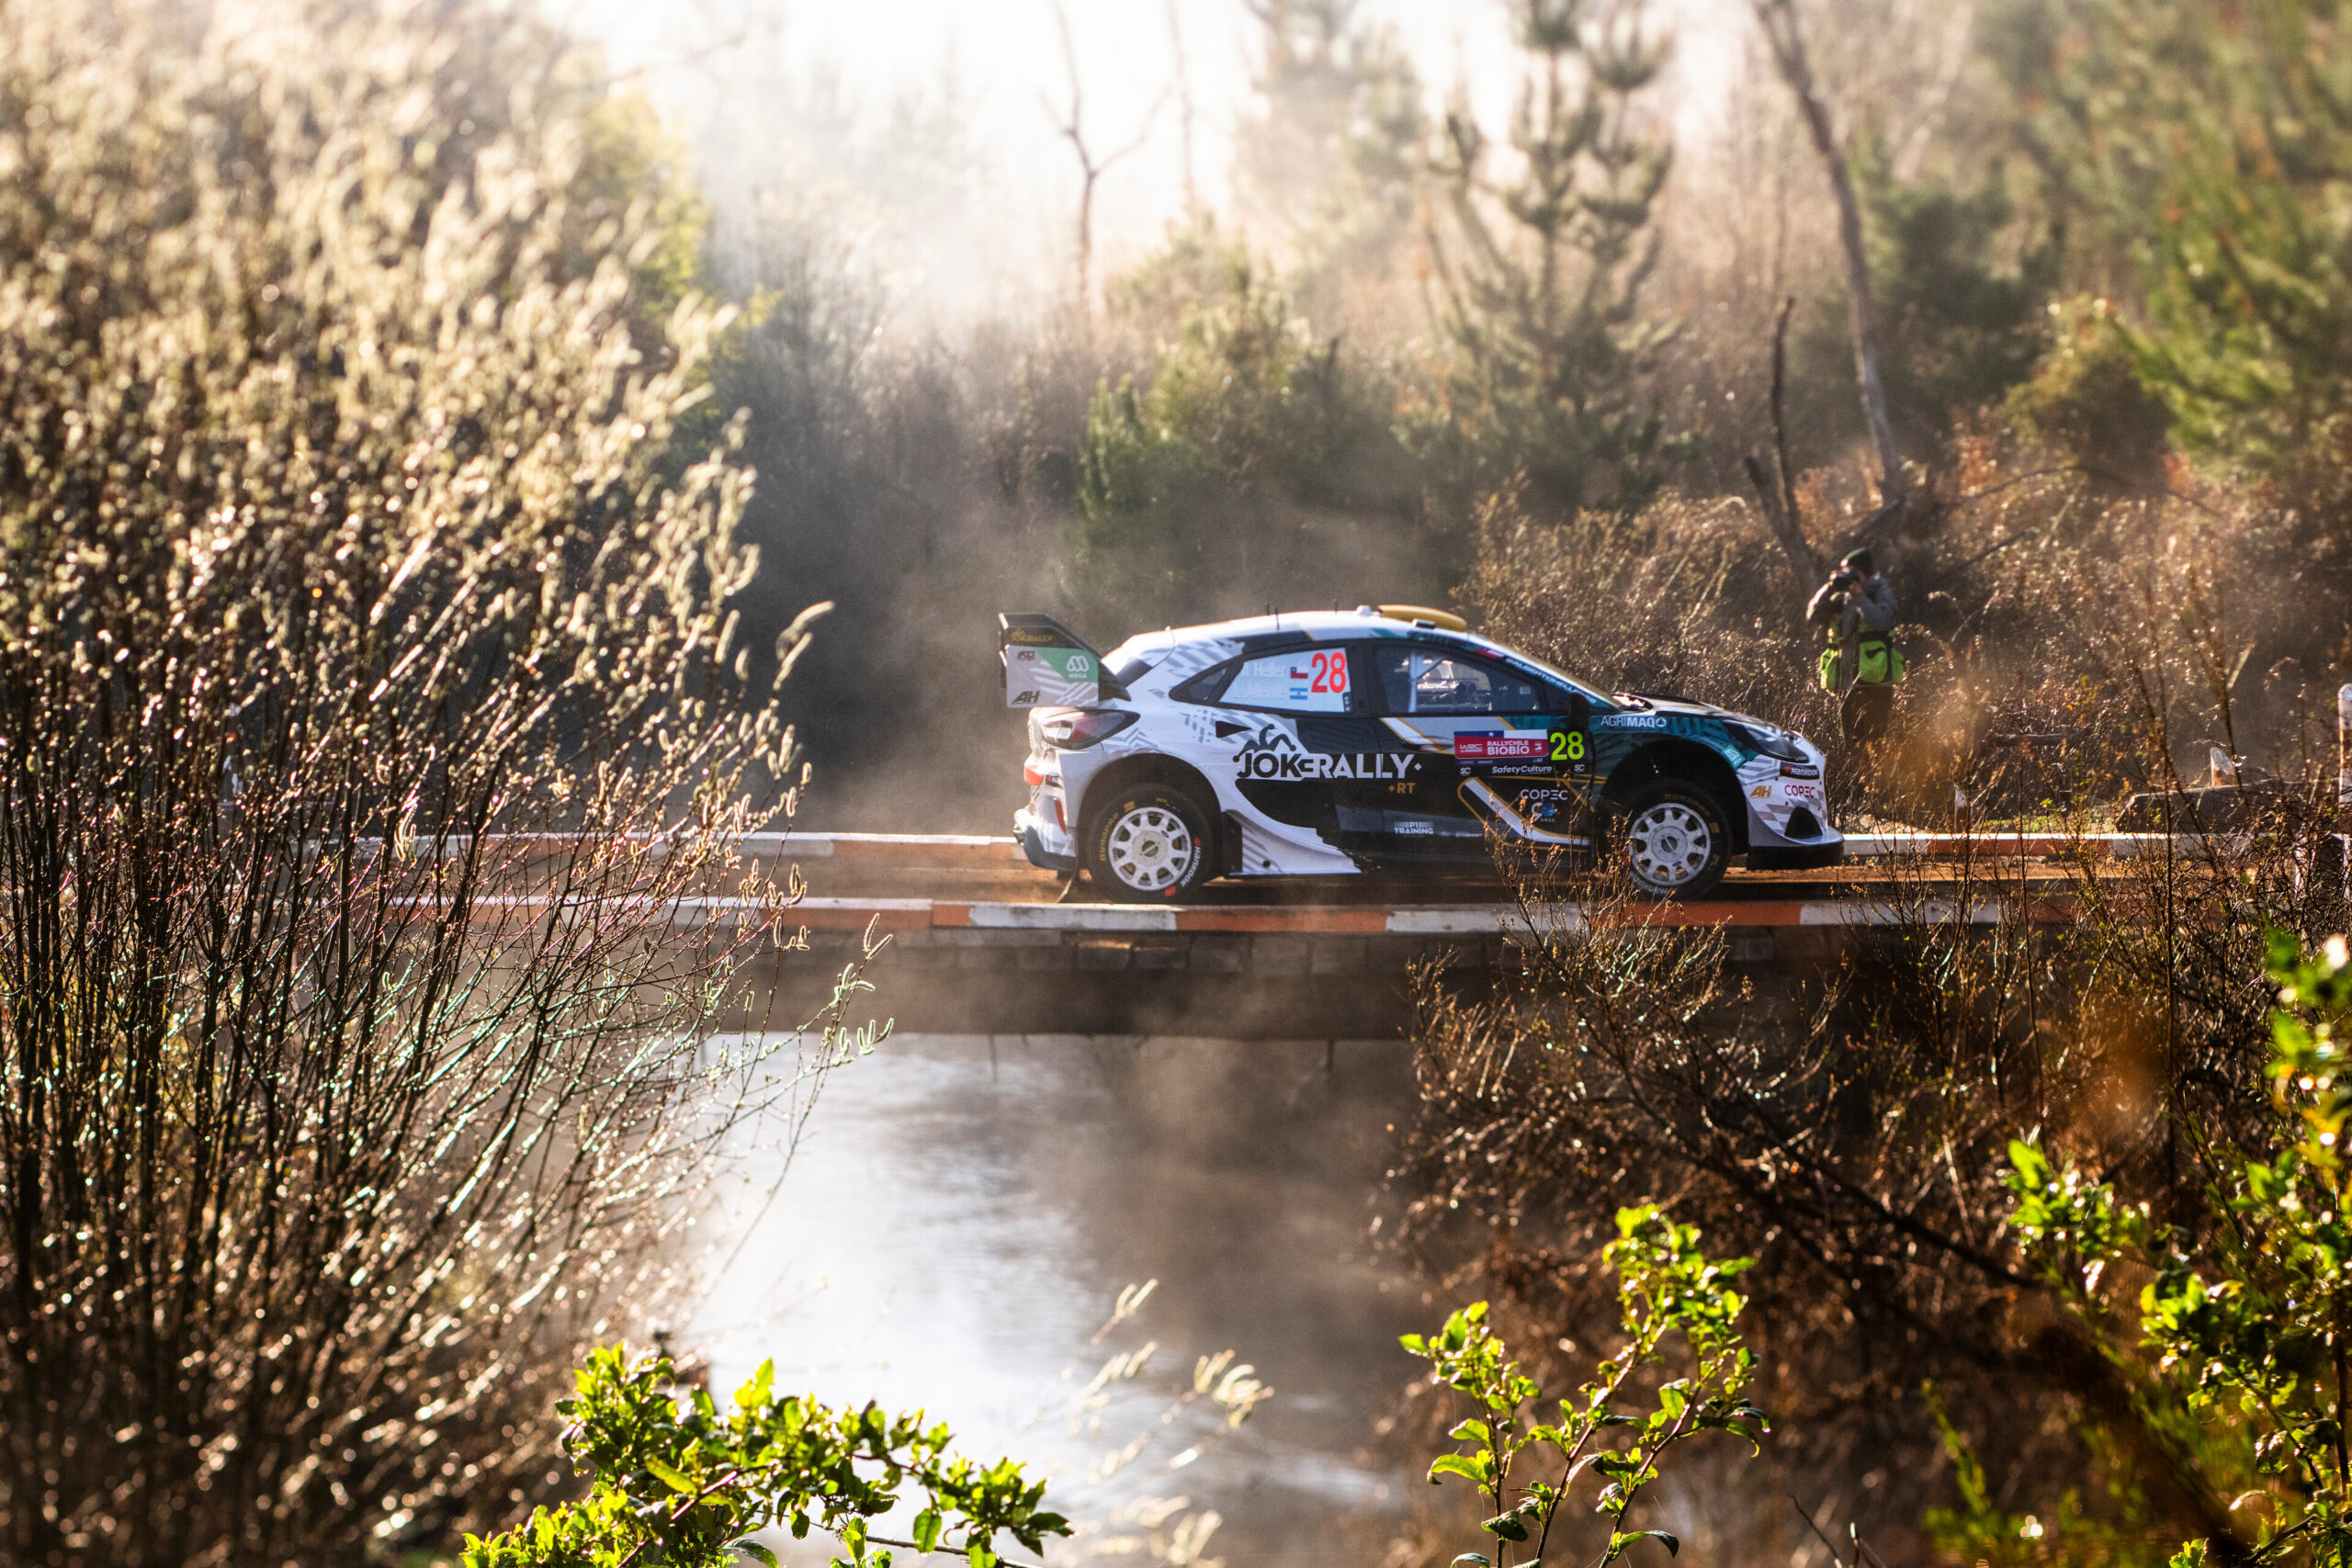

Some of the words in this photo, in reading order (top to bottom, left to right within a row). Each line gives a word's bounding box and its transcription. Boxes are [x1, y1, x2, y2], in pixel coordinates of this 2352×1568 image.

[1254, 661, 1286, 678] Heller
[1311, 652, 1347, 694] 28
[1012, 691, 1040, 705] AH
[1600, 716, 1656, 728] AGRIMAQ
[1550, 731, 1585, 761] 28
[1236, 752, 1415, 779] JOKERALLY
[1492, 764, 1553, 774] SafetyCulture
[1520, 789, 1568, 800] COPEC
[1749, 785, 1772, 798] AH
[1784, 784, 1815, 798] COPEC
